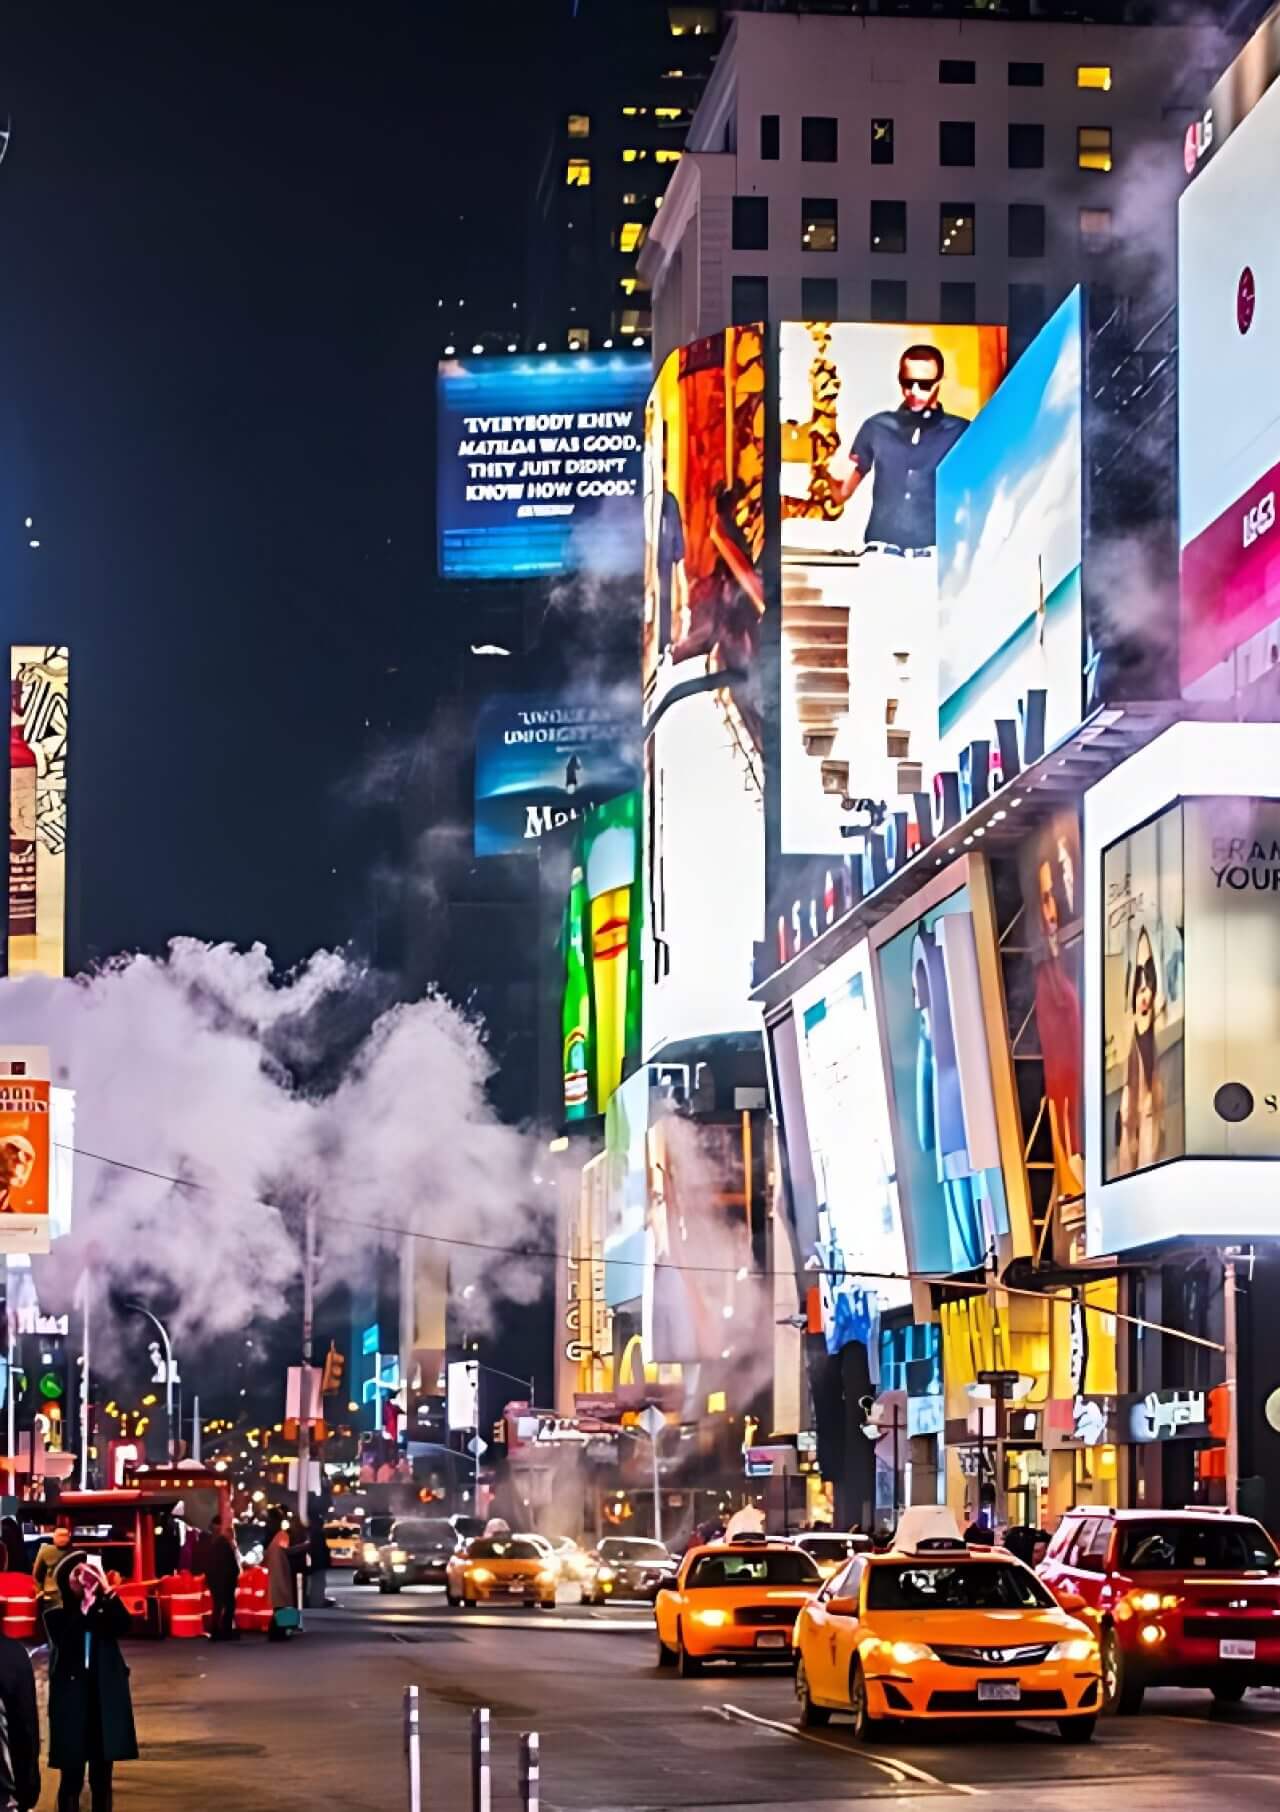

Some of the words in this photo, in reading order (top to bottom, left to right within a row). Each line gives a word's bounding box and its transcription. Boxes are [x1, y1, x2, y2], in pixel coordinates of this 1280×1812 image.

[458, 438, 536, 456] MATILDA
[539, 437, 580, 452] WAS
[468, 462, 516, 478] THEY
[519, 460, 561, 477] JUST
[565, 457, 627, 474] DIDN'T
[466, 484, 524, 501] KNOW
[527, 482, 573, 498] HOW
